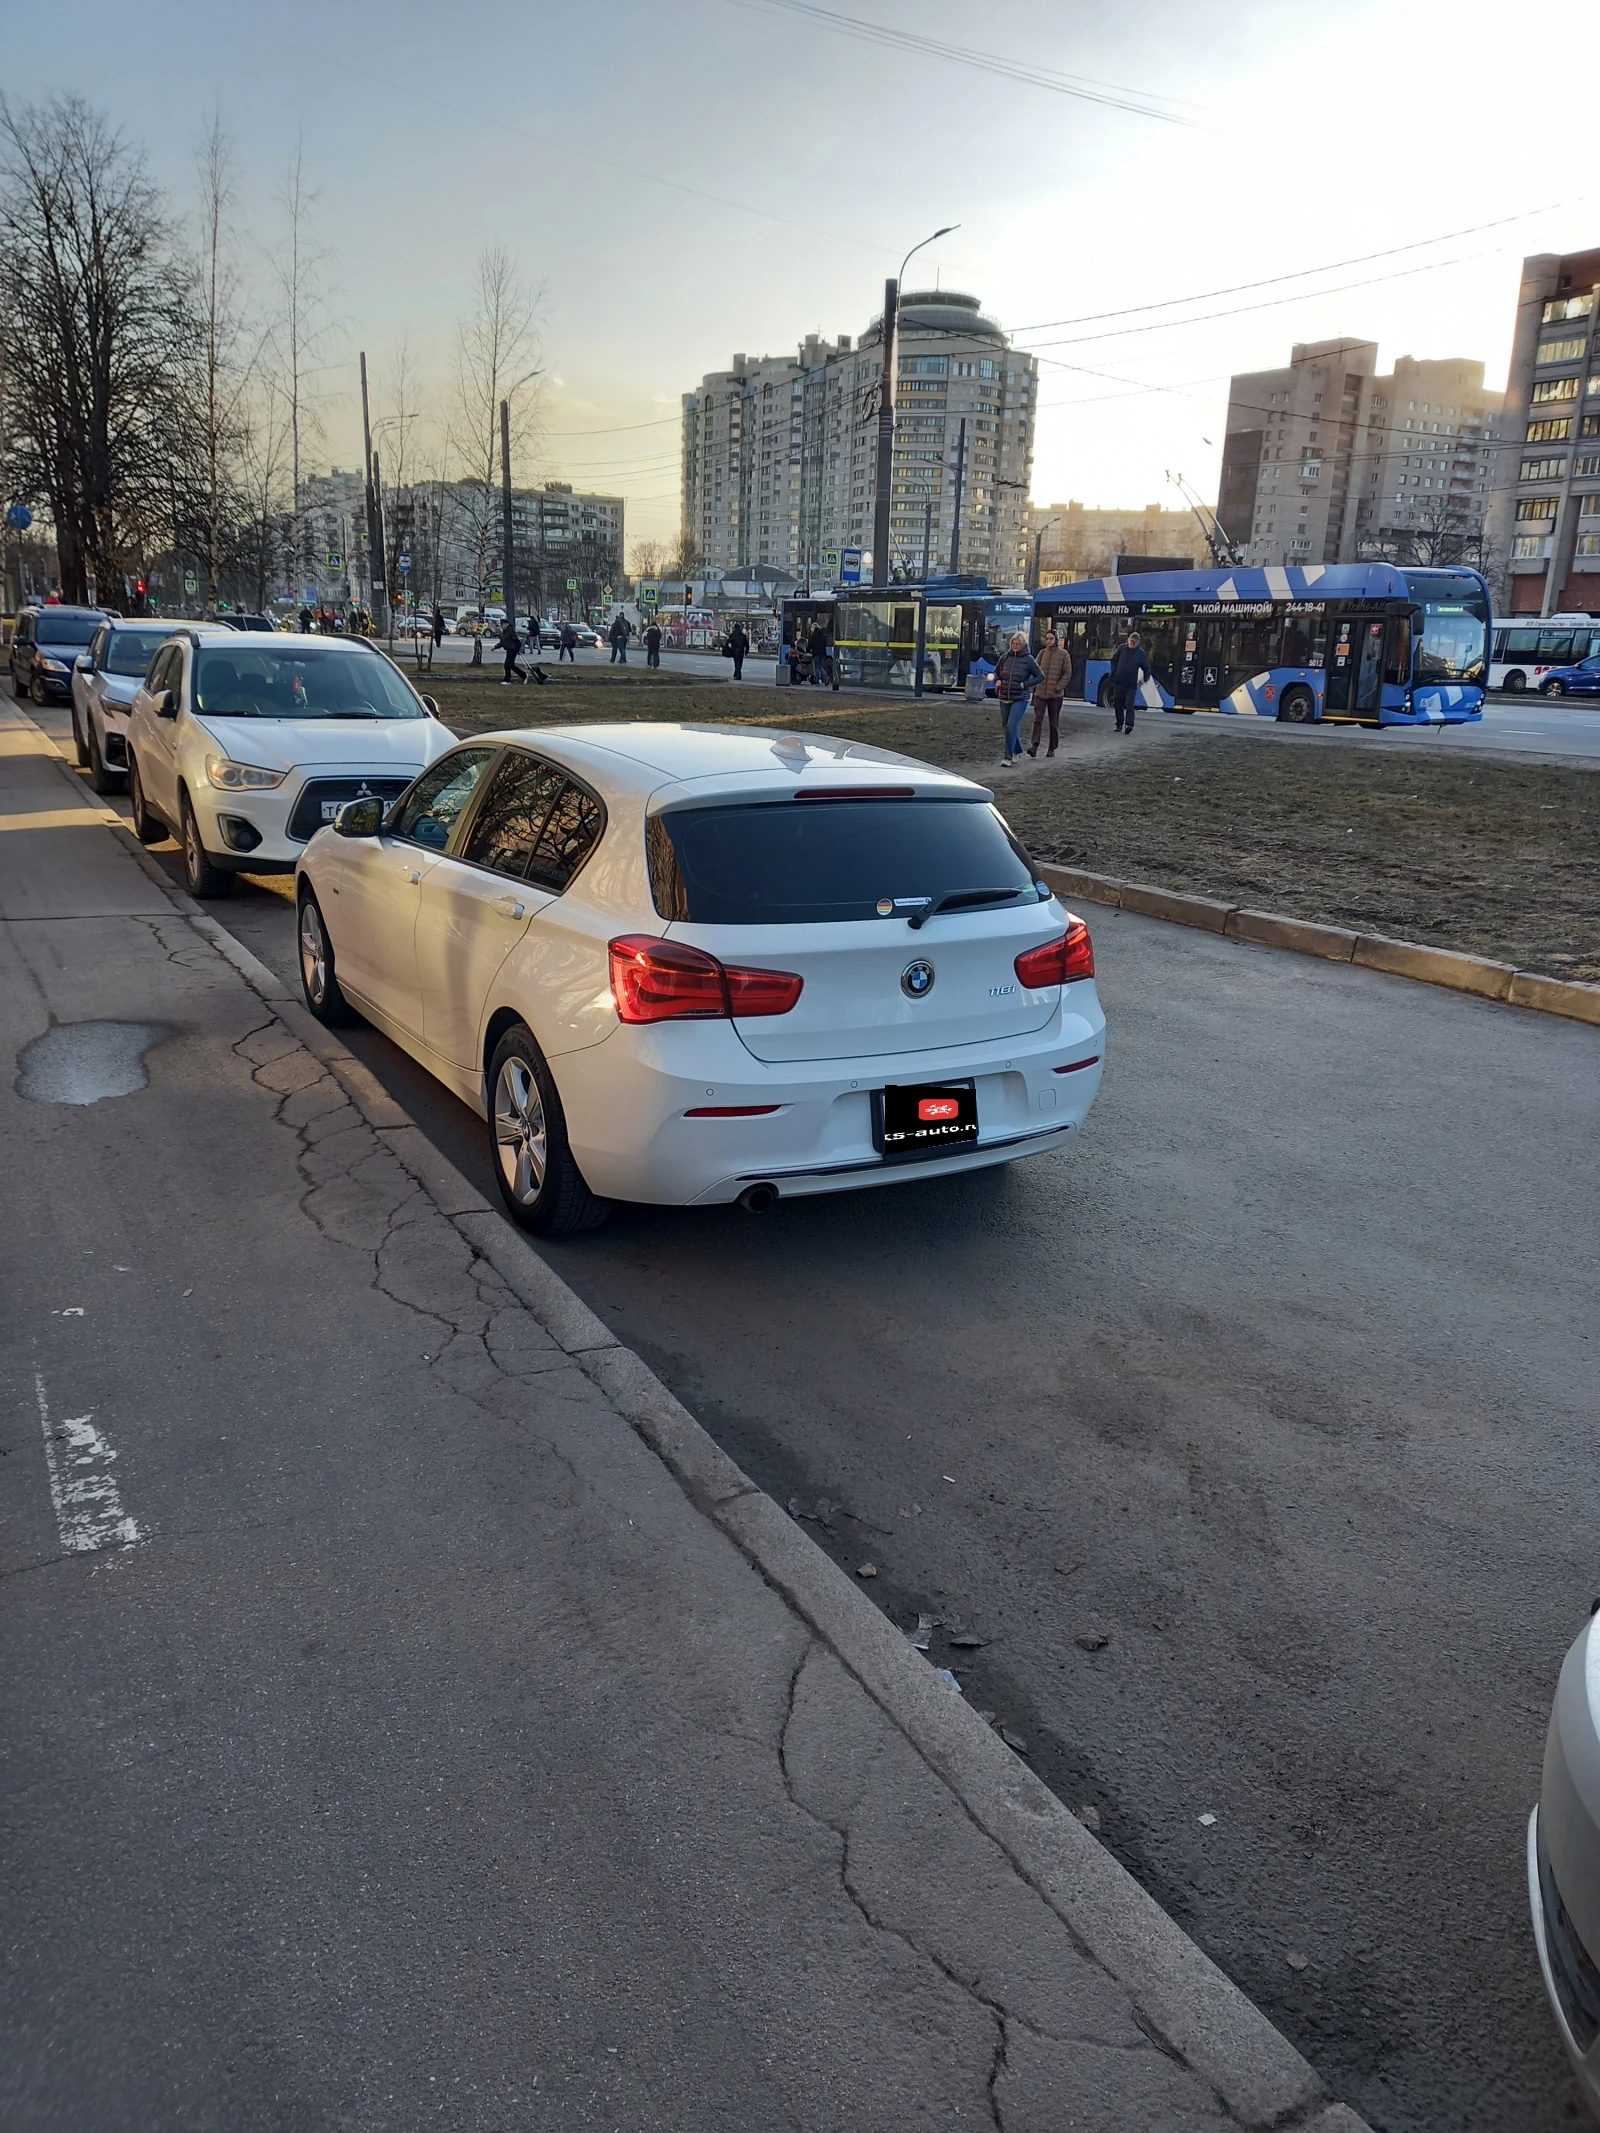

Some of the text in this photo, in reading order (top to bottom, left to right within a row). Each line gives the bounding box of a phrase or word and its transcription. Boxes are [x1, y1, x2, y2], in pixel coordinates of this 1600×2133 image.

[1058, 605, 1129, 614] НАУЧИМ УПРАВЛЯТЬ
[1192, 601, 1273, 613] ТАКОЙ МАШИНОЙ!
[1285, 602, 1325, 612] 244-18-41
[1309, 659, 1323, 667] 5012
